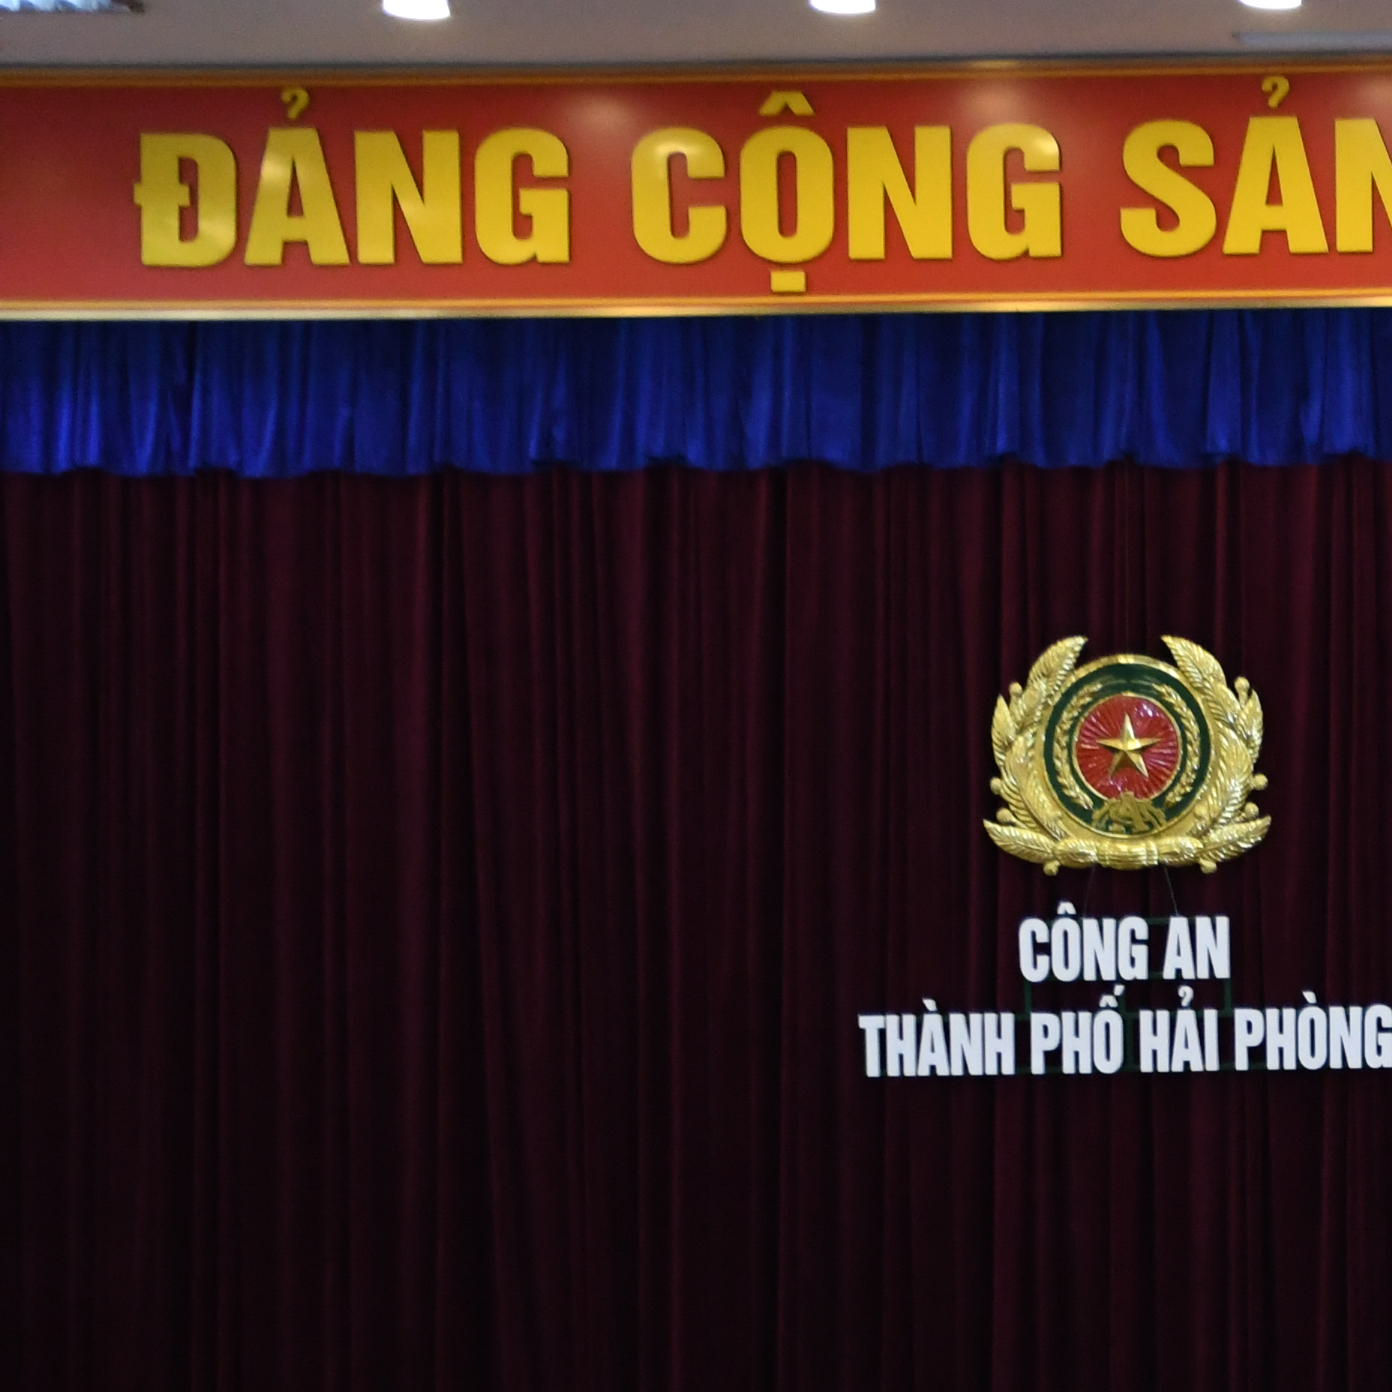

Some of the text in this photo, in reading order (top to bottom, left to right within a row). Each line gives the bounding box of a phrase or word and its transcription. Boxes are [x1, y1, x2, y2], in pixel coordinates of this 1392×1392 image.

[134, 88, 571, 268] ĐẢNG
[632, 92, 1063, 293] CỘNG
[1018, 901, 1231, 982] CÔNG AN
[857, 998, 1016, 1078] THÀNH
[1030, 985, 1125, 1076] PHỐ
[1139, 986, 1220, 1074] HẢI
